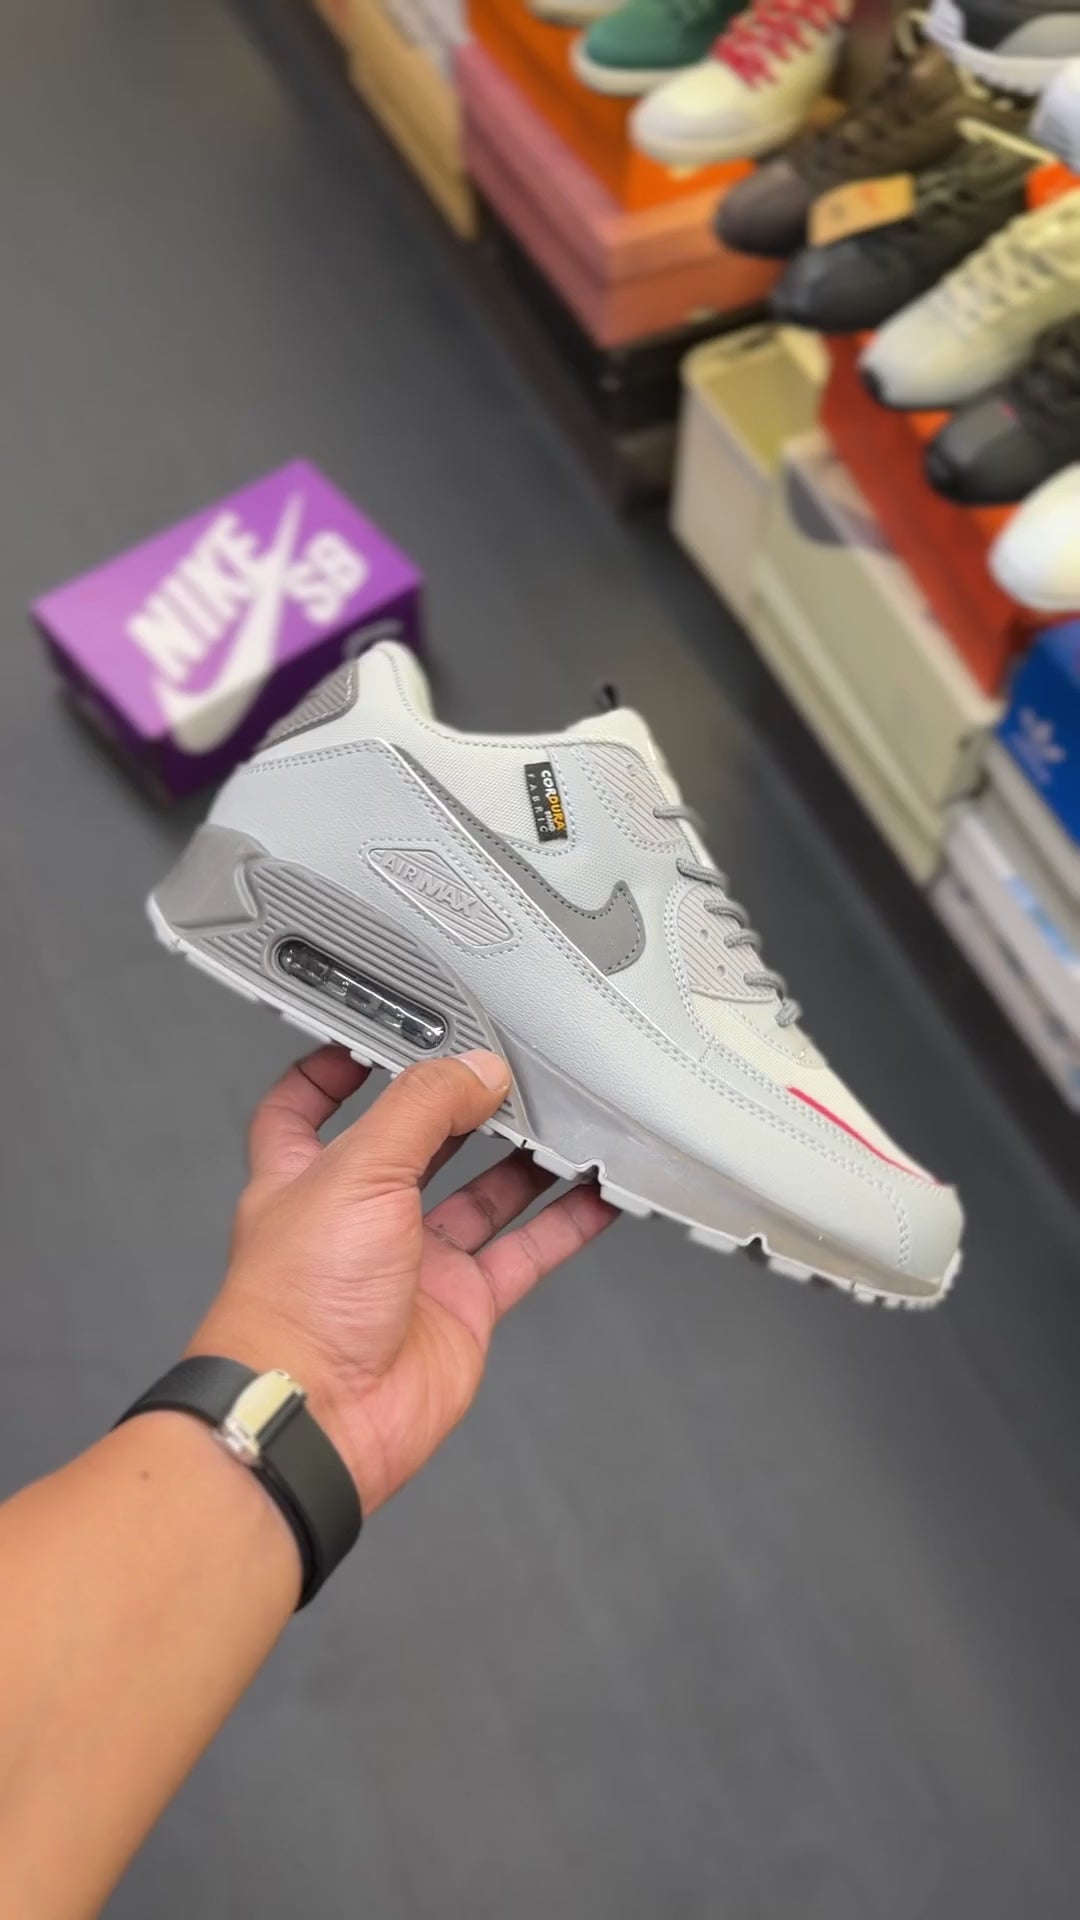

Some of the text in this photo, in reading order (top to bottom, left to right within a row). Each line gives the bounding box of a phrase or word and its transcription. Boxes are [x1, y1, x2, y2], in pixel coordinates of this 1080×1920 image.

[127, 511, 369, 683] NIKE SB
[541, 769, 566, 831] CORDURA
[383, 854, 477, 918] AIR MAX
